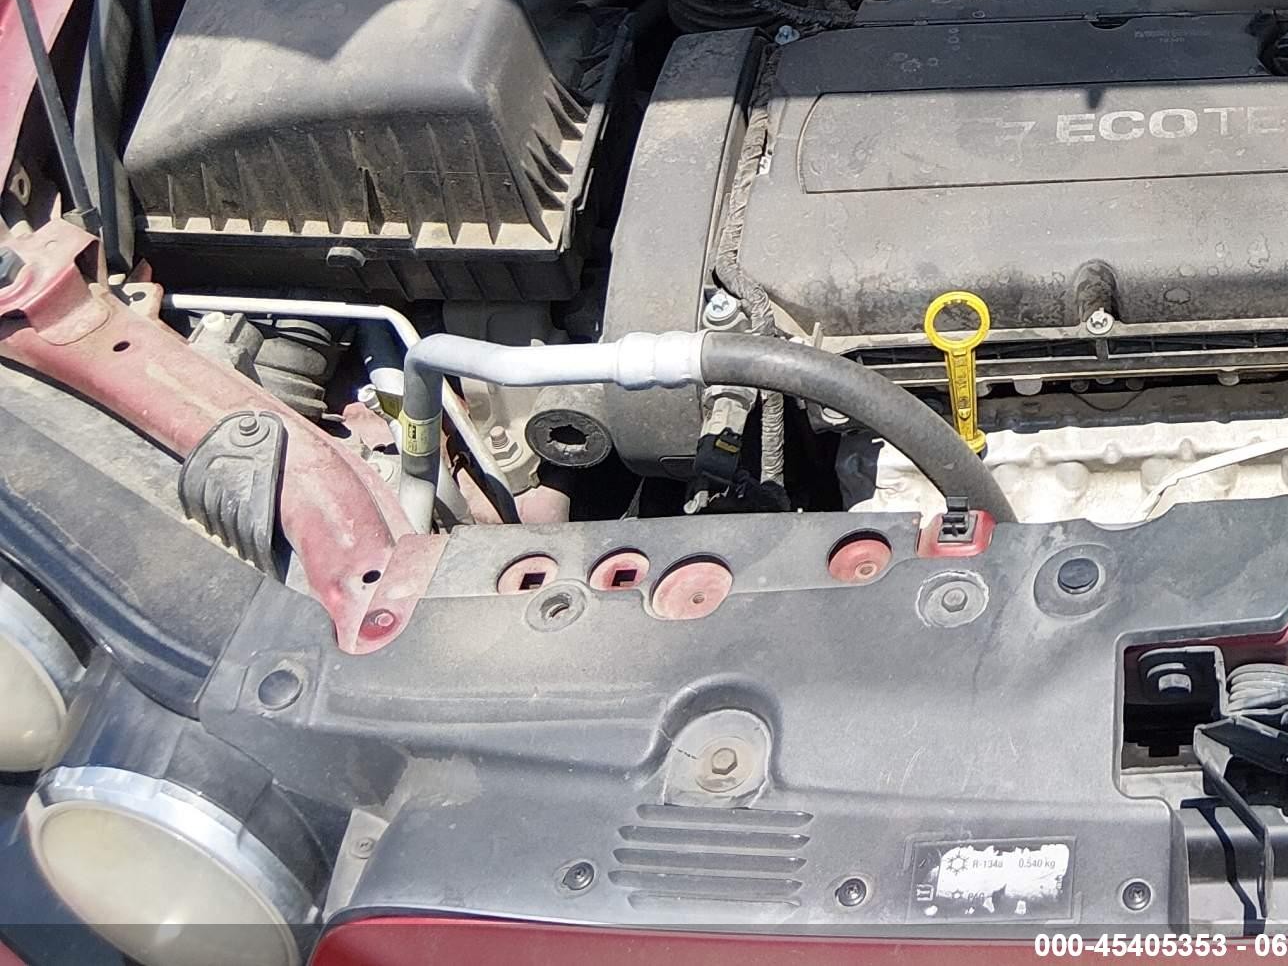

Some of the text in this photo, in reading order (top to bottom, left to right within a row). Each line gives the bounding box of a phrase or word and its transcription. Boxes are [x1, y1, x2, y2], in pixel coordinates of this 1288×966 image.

[972, 858, 1056, 870] R-134a 0.540 kg
